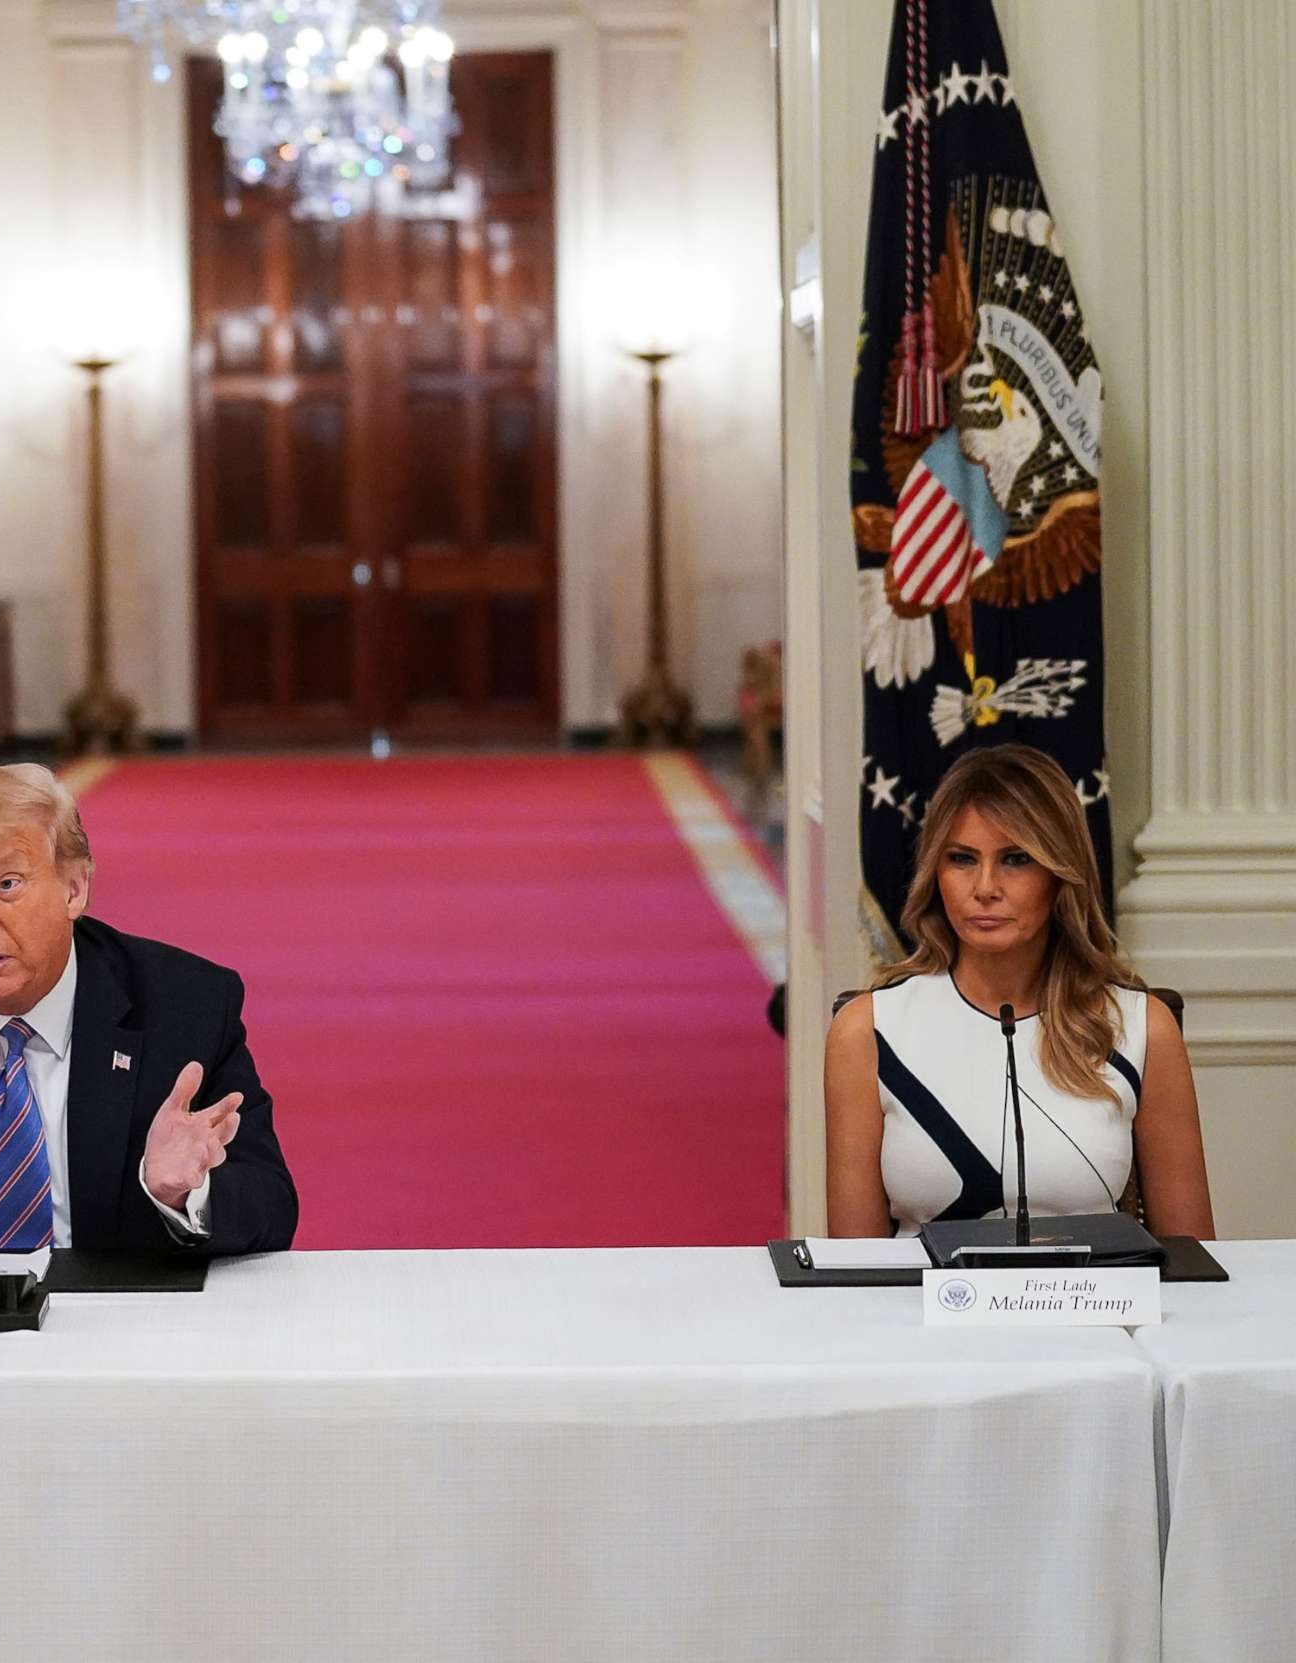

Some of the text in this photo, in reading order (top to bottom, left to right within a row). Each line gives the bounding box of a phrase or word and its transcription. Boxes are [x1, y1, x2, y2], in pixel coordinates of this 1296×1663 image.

[999, 319, 1072, 411] PLURIBUS
[1025, 1280, 1097, 1294] First Lady
[988, 1295, 1134, 1314] Melania Trump
